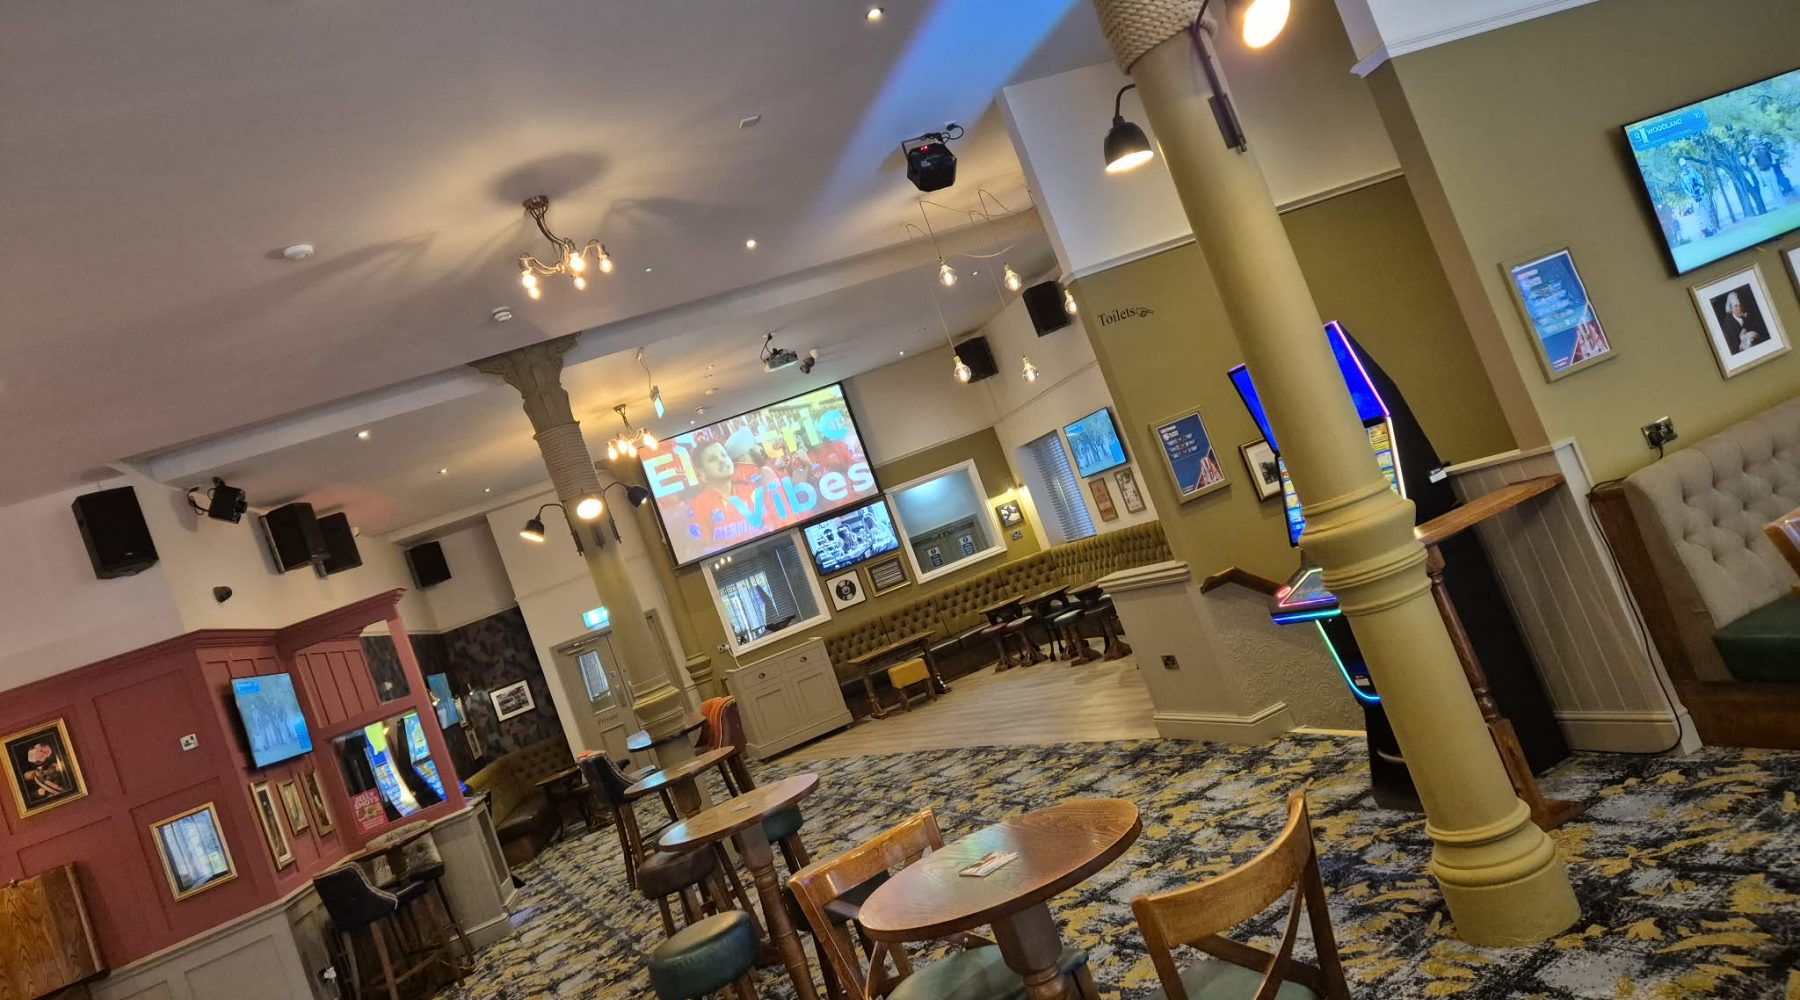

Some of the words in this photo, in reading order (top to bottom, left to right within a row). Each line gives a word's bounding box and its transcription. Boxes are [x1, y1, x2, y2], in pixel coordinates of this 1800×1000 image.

[1646, 118, 1683, 135] WOODLAND
[1098, 307, 1136, 327] Toilets
[729, 461, 875, 529] Vibes
